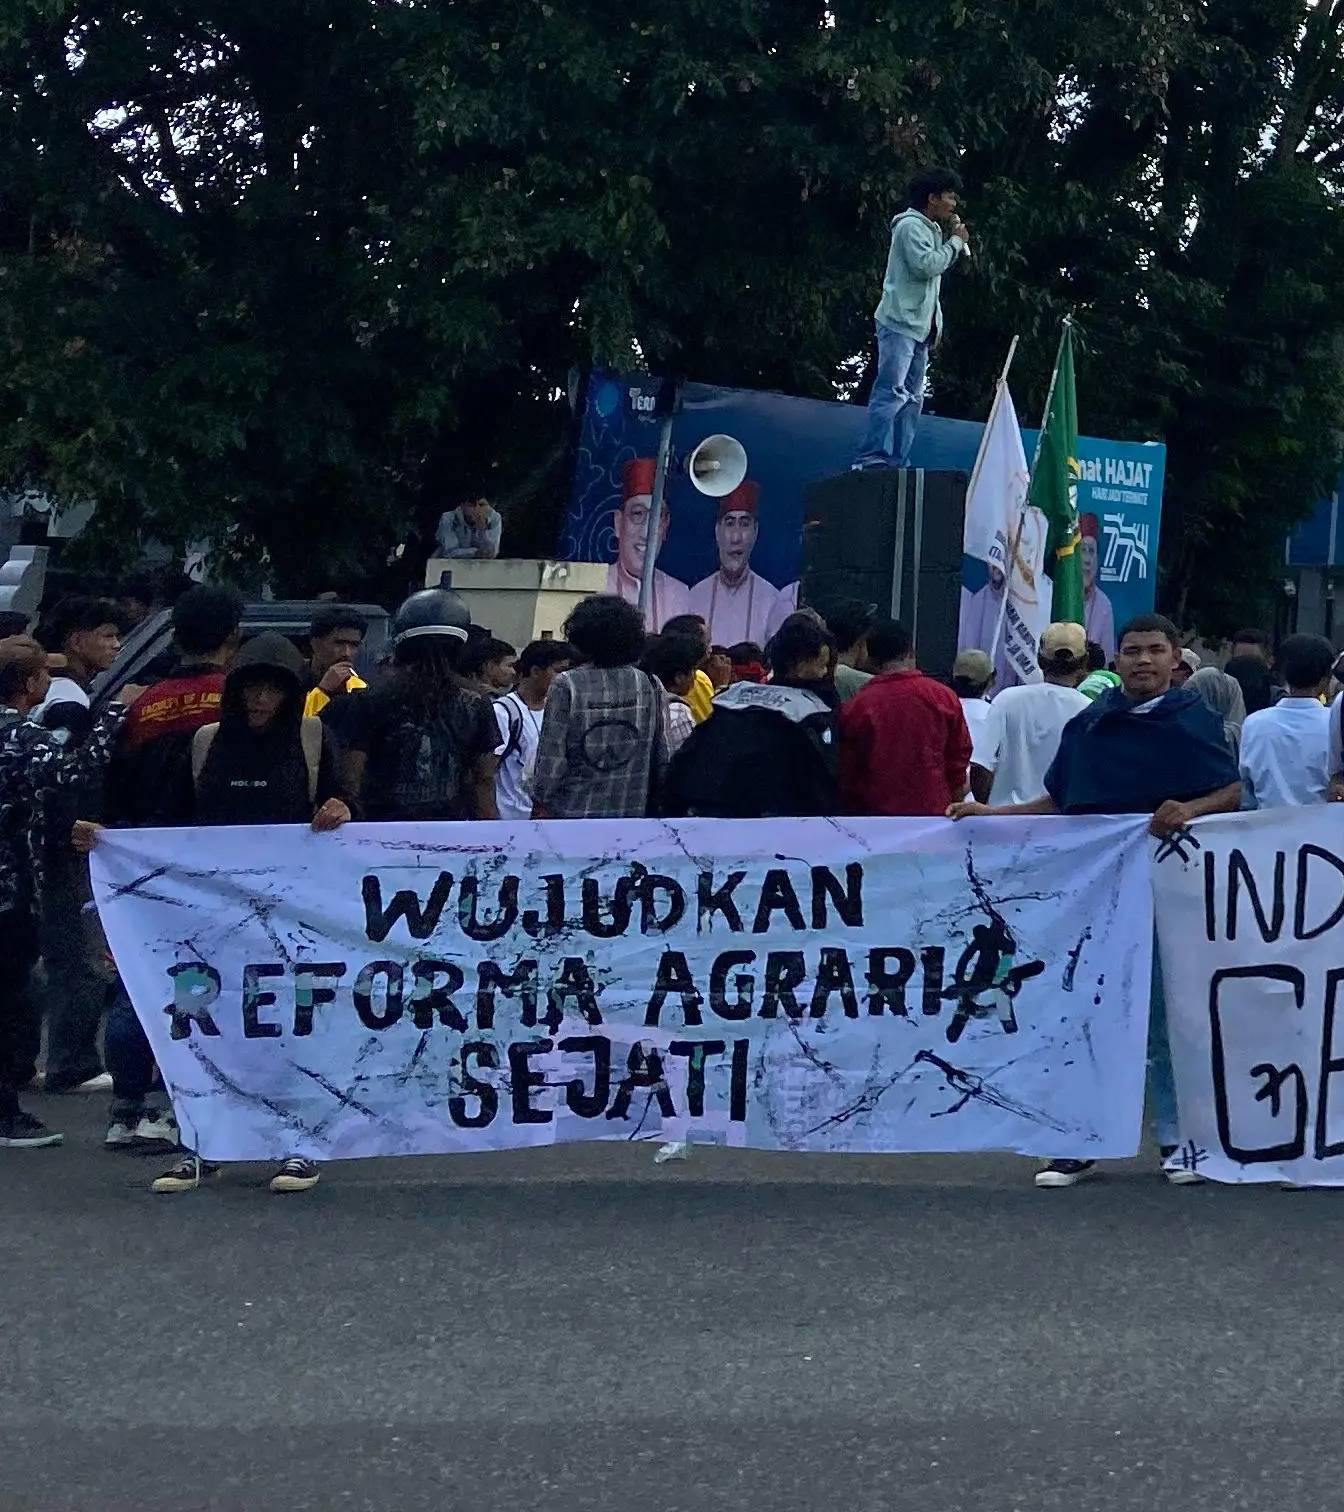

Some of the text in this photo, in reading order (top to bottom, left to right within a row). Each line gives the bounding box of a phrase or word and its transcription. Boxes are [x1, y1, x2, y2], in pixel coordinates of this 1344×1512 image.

[1105, 456, 1154, 489] HAJAT
[362, 861, 864, 941] WUJUDKAN
[163, 925, 1045, 1043] REFORMA AGRARIA
[448, 1037, 750, 1129] SEJATI
